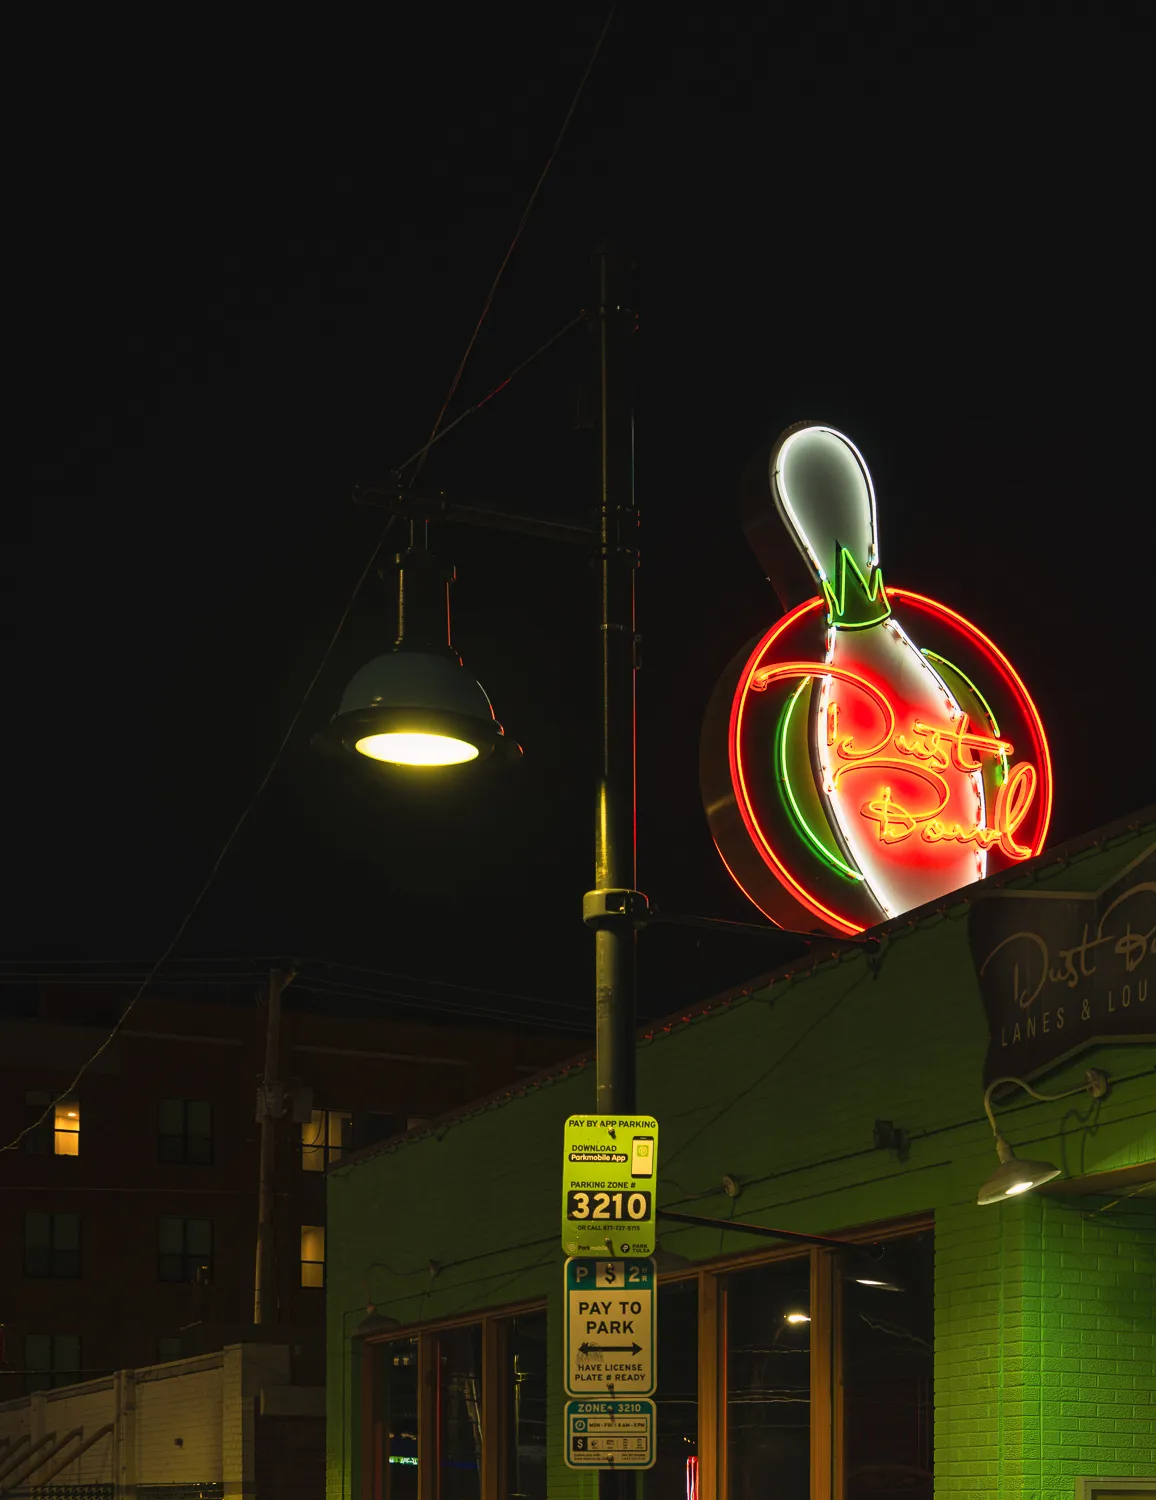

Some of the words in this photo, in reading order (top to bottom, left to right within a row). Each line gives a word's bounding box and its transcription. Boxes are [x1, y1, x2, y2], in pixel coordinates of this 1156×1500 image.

[750, 661, 1014, 772] Dust
[826, 757, 1037, 860] Bowl
[980, 923, 1115, 1009] Dust
[1001, 1007, 1065, 1047] LANES
[1081, 998, 1091, 1021] &
[568, 1120, 584, 1128] PAY
[586, 1120, 598, 1128] BY
[599, 1120, 617, 1128] APP
[618, 1121, 656, 1129] PARKING
[571, 1144, 617, 1152] DOWNLOAD
[571, 1154, 611, 1162] Parkmobile
[611, 1154, 626, 1163] App
[570, 1181, 606, 1189] PARKING
[607, 1181, 629, 1189] ZONE
[571, 1192, 647, 1220] 3210
[576, 1266, 588, 1282] P
[578, 1301, 612, 1315] PAY
[619, 1301, 642, 1315] TO
[586, 1320, 634, 1334] PARK
[578, 1403, 607, 1412] ZONE
[617, 1404, 641, 1412] 3210
